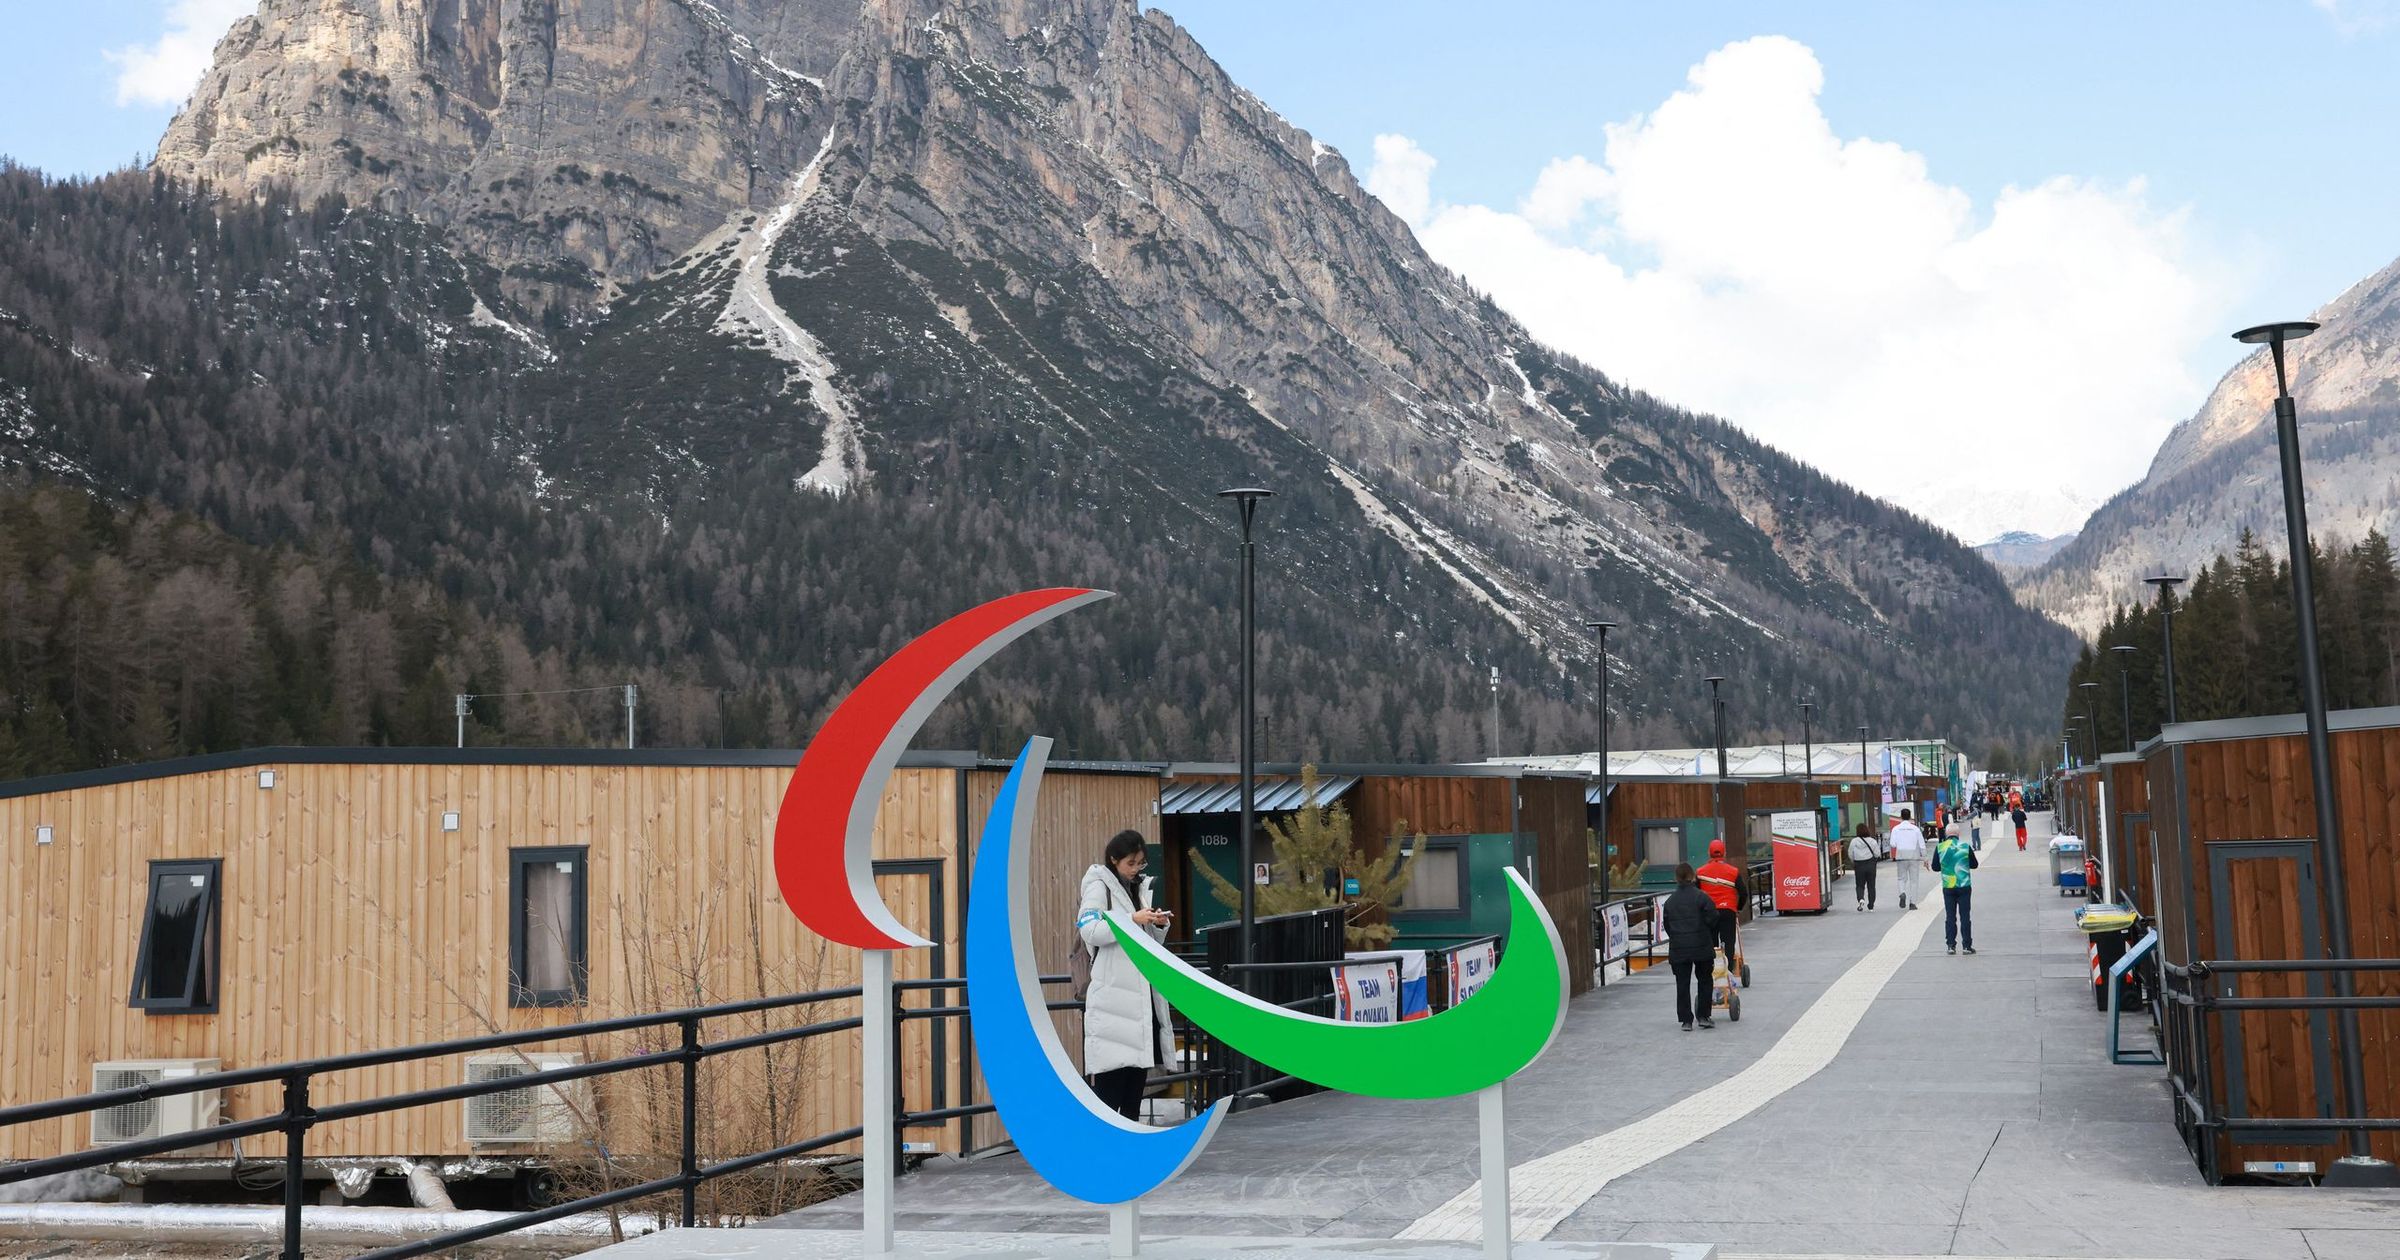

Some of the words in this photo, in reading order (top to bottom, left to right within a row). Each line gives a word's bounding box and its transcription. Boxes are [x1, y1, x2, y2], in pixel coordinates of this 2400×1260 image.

[1200, 834, 1228, 846] 108b
[1466, 958, 1481, 977] TEAM
[1357, 979, 1381, 999] TEAM
[1354, 1006, 1389, 1022] SLOVAKIA
